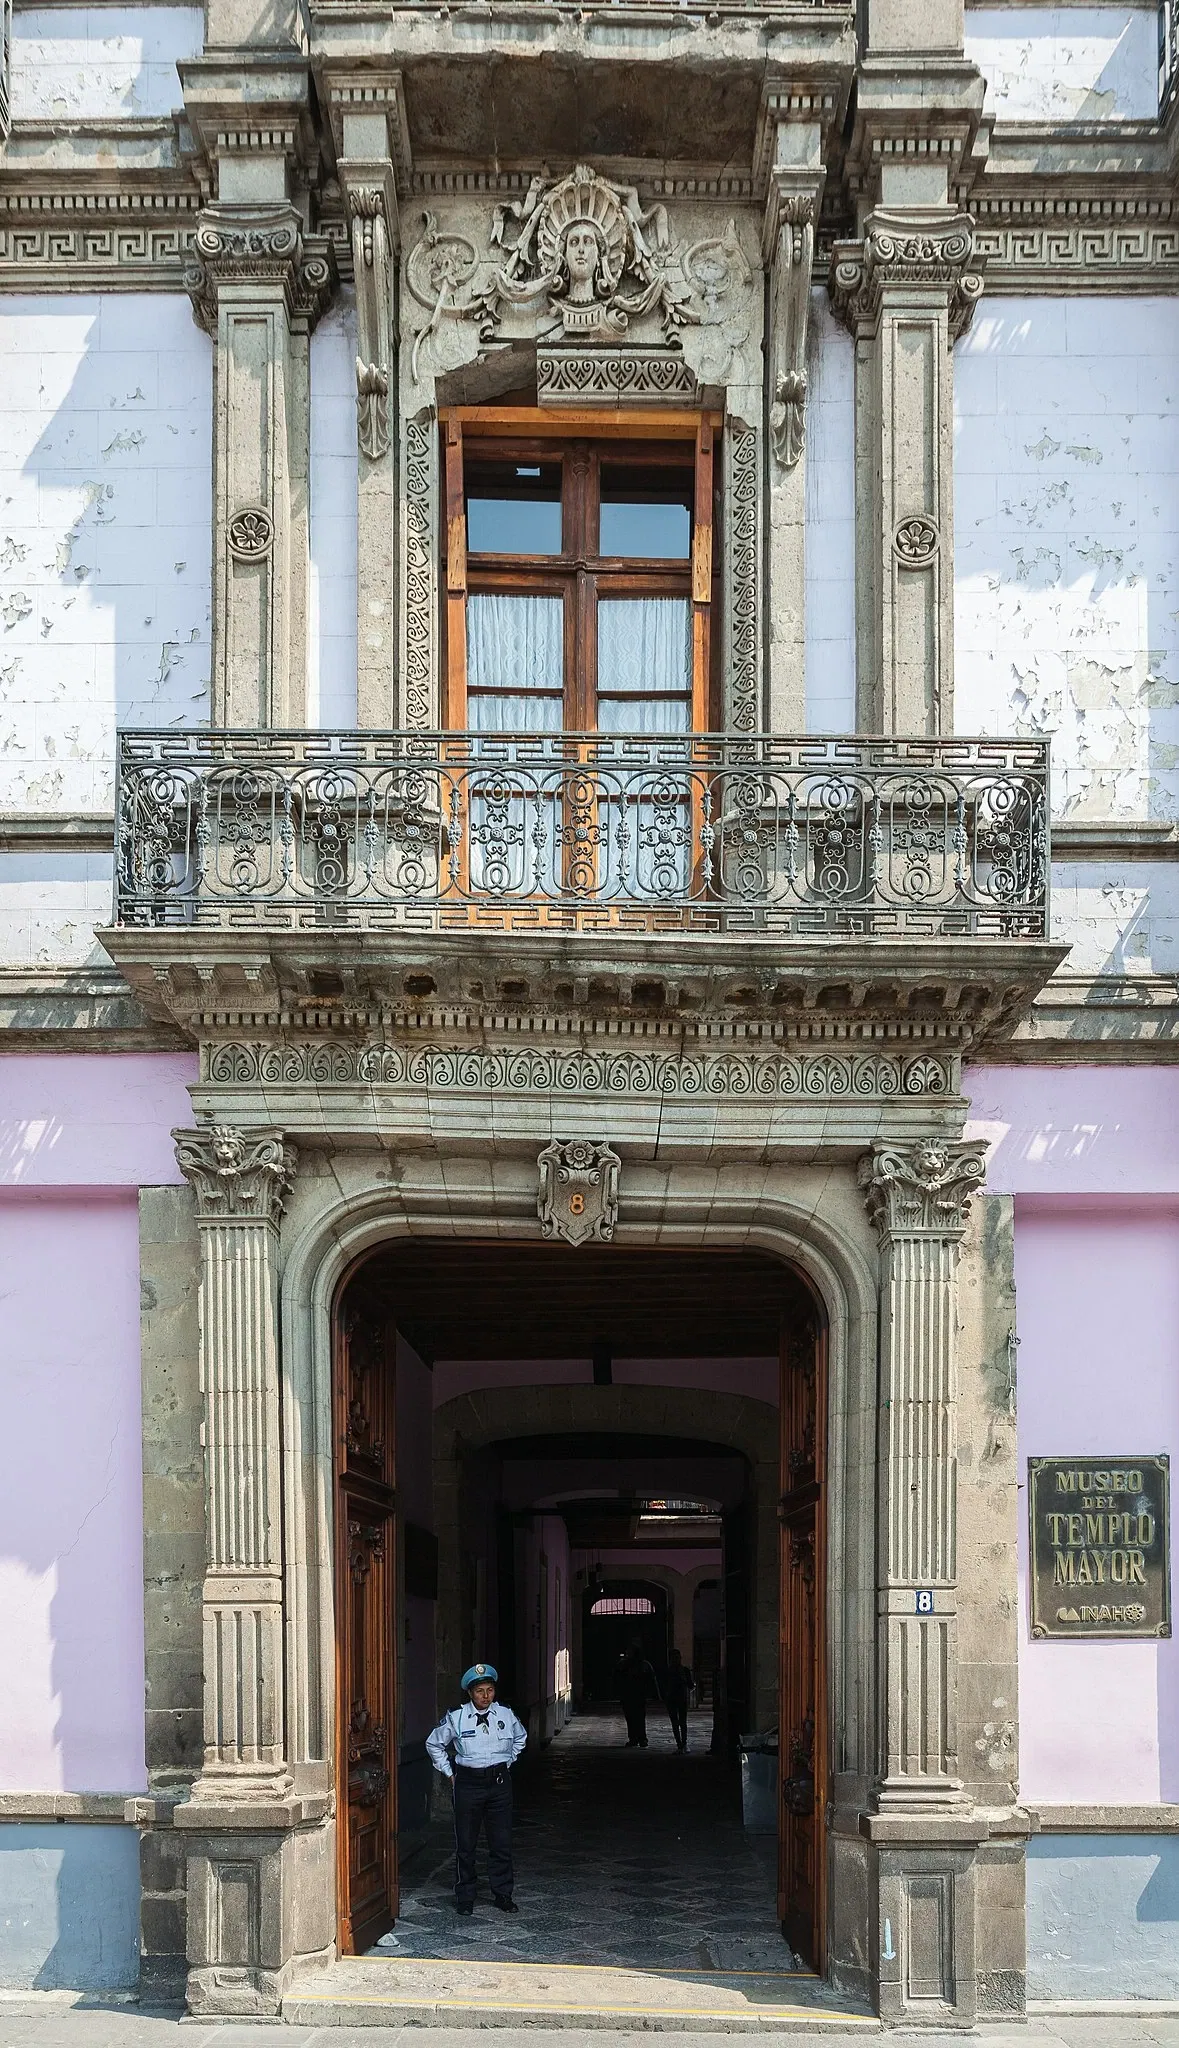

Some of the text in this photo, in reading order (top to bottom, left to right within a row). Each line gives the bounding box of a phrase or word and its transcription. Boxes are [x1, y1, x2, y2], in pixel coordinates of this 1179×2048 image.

[569, 1193, 585, 1215] 8
[1056, 1471, 1144, 1493] MUSEO
[1083, 1496, 1117, 1509] DEL
[1047, 1513, 1155, 1547] TEMPLO
[1054, 1550, 1146, 1584] MAYOR
[918, 1591, 932, 1612] 8
